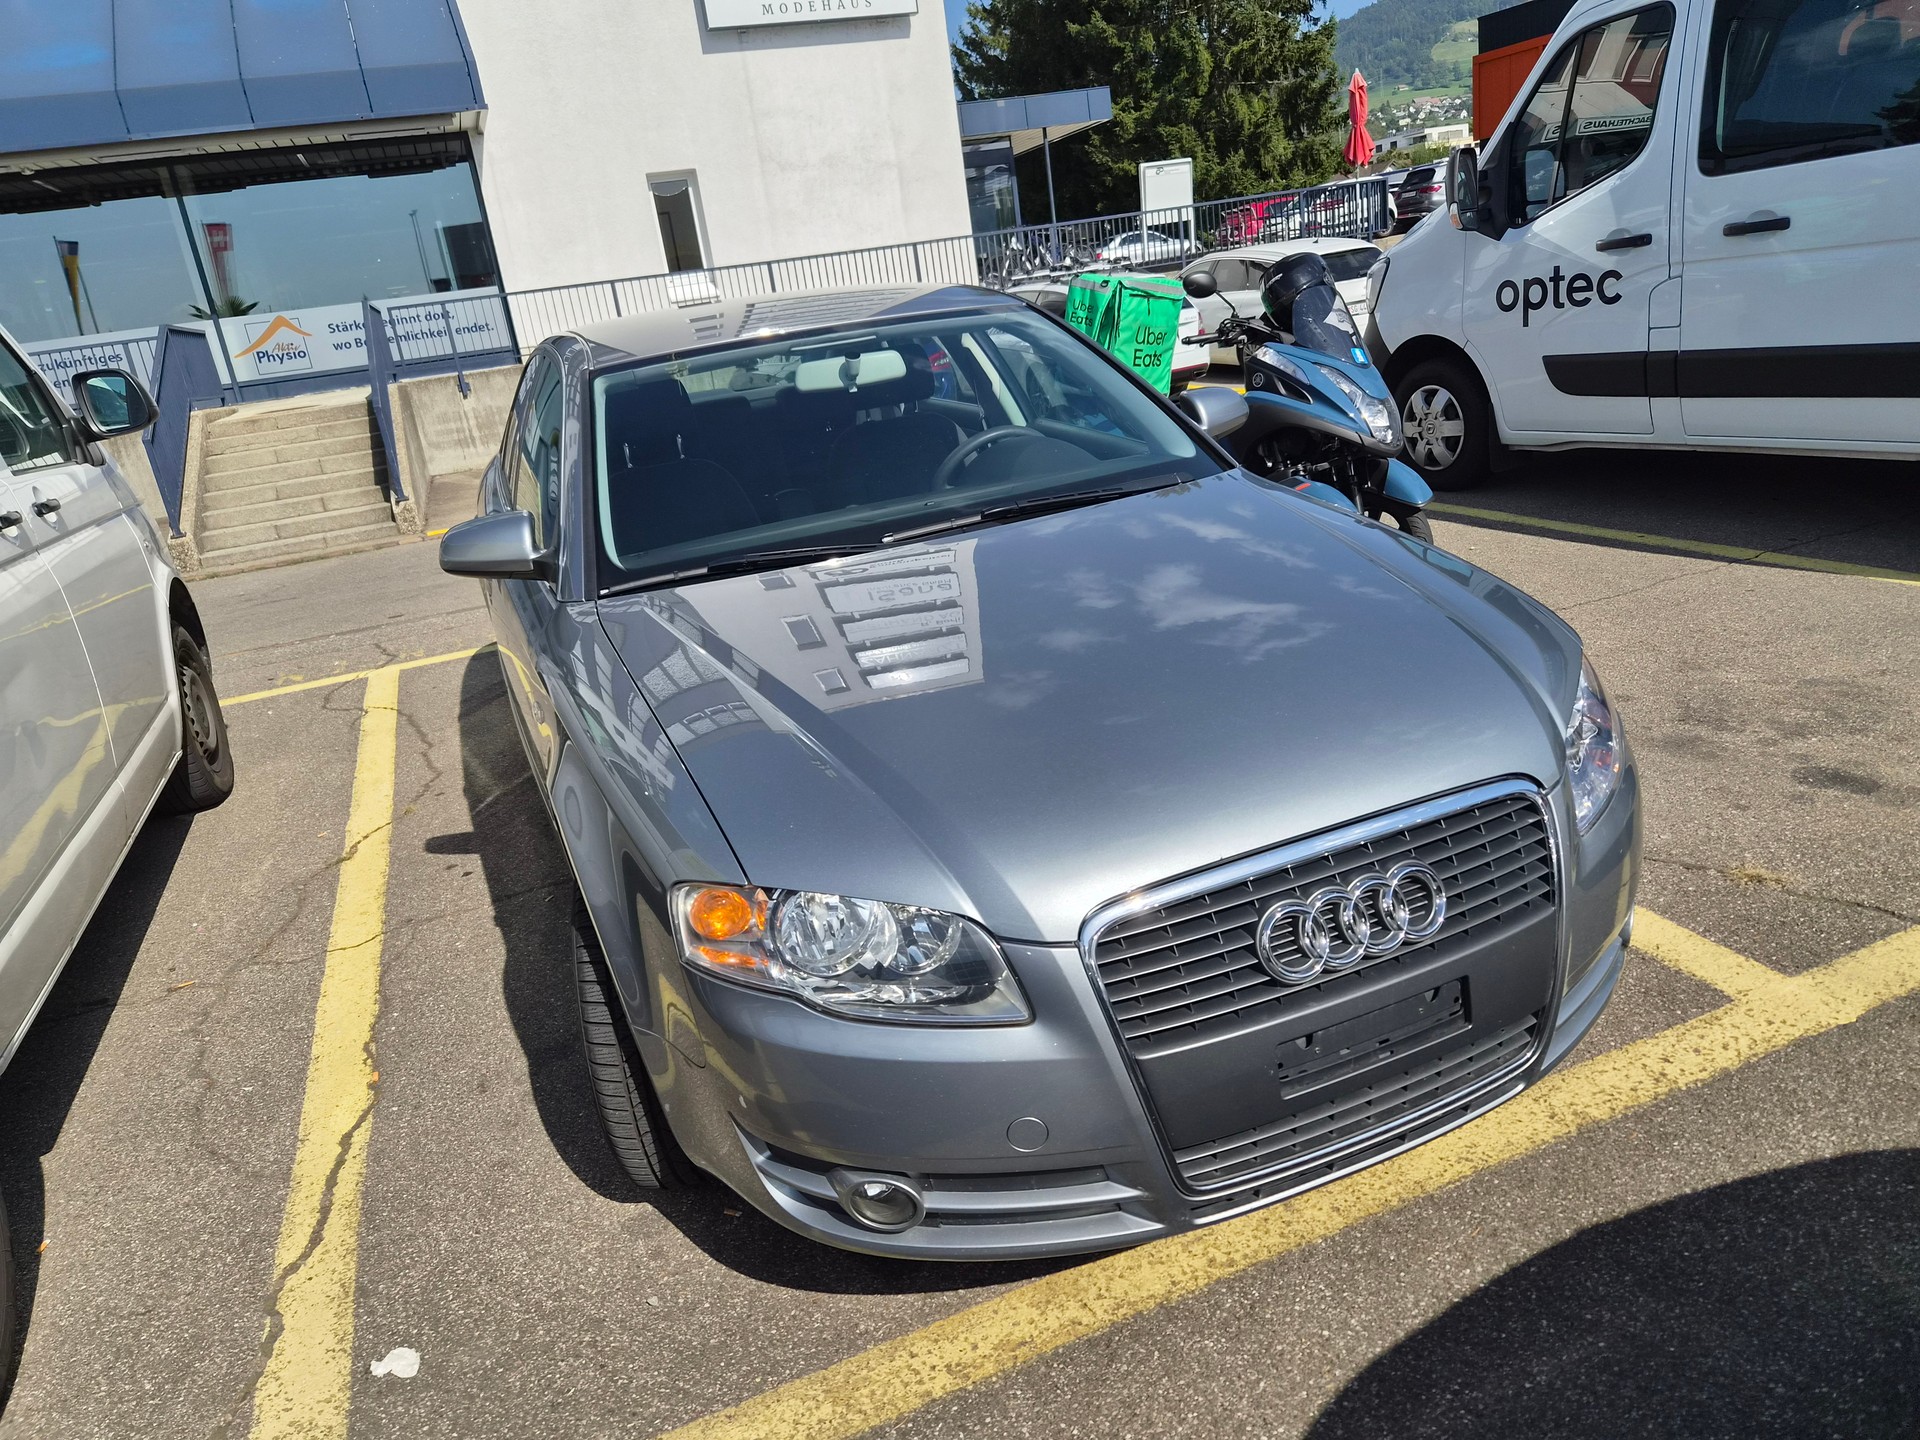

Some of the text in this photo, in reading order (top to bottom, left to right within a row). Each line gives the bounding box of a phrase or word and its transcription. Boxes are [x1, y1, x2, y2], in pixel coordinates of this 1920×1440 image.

[762, 0, 872, 15] MODEHAUS
[1496, 266, 1623, 327] optec
[383, 313, 422, 328] einnt
[1070, 311, 1093, 327] Eats
[332, 341, 352, 350] wo
[455, 322, 494, 335] endet.
[1135, 326, 1167, 346] Uber
[271, 342, 301, 353] Aktiv
[256, 350, 306, 365] Physio
[1132, 349, 1162, 367] Eats
